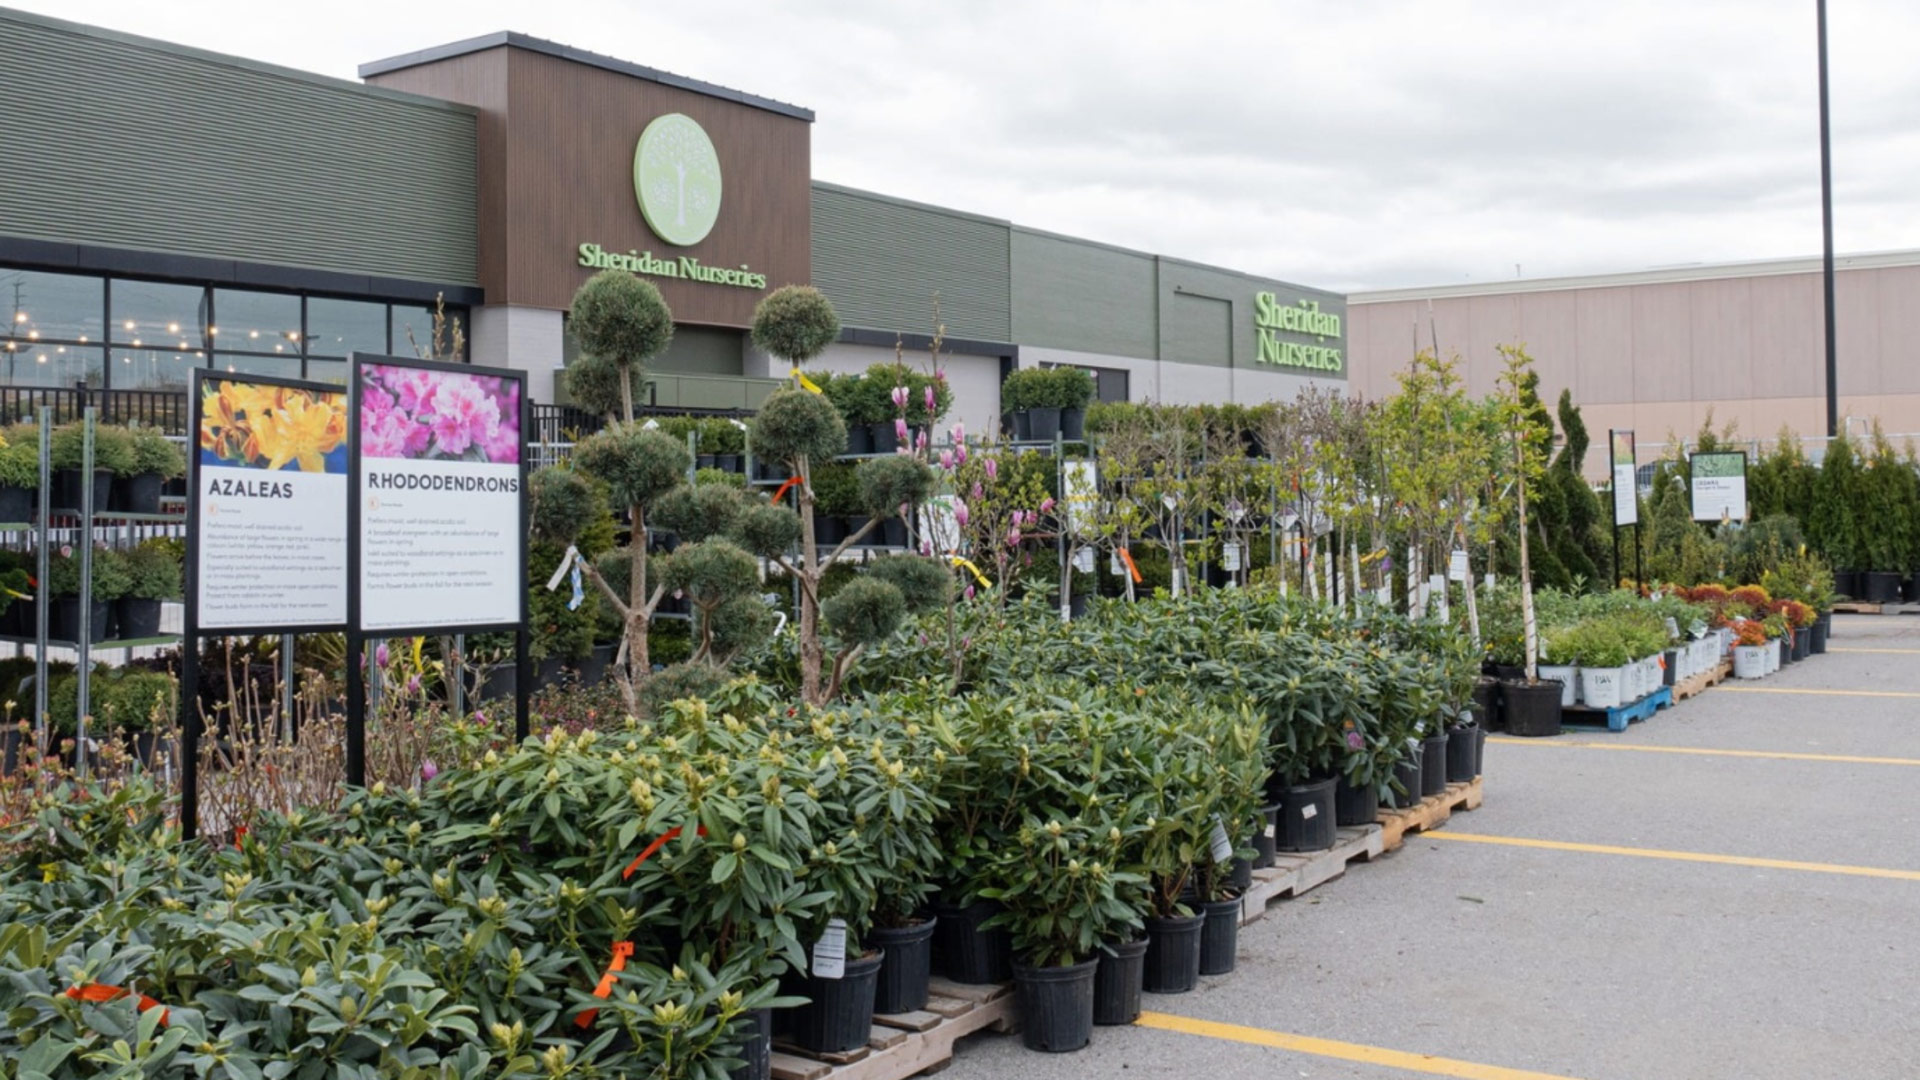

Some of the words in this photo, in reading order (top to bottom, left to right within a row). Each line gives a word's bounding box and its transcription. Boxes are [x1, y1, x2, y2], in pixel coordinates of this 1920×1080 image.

[578, 243, 677, 277] Sheridan
[678, 256, 766, 289] Nurseries
[1255, 291, 1341, 337] Sheridan
[1255, 327, 1342, 371] Nurseries
[209, 478, 293, 499] AZALEAS
[368, 472, 518, 493] RHODODENDRONS
